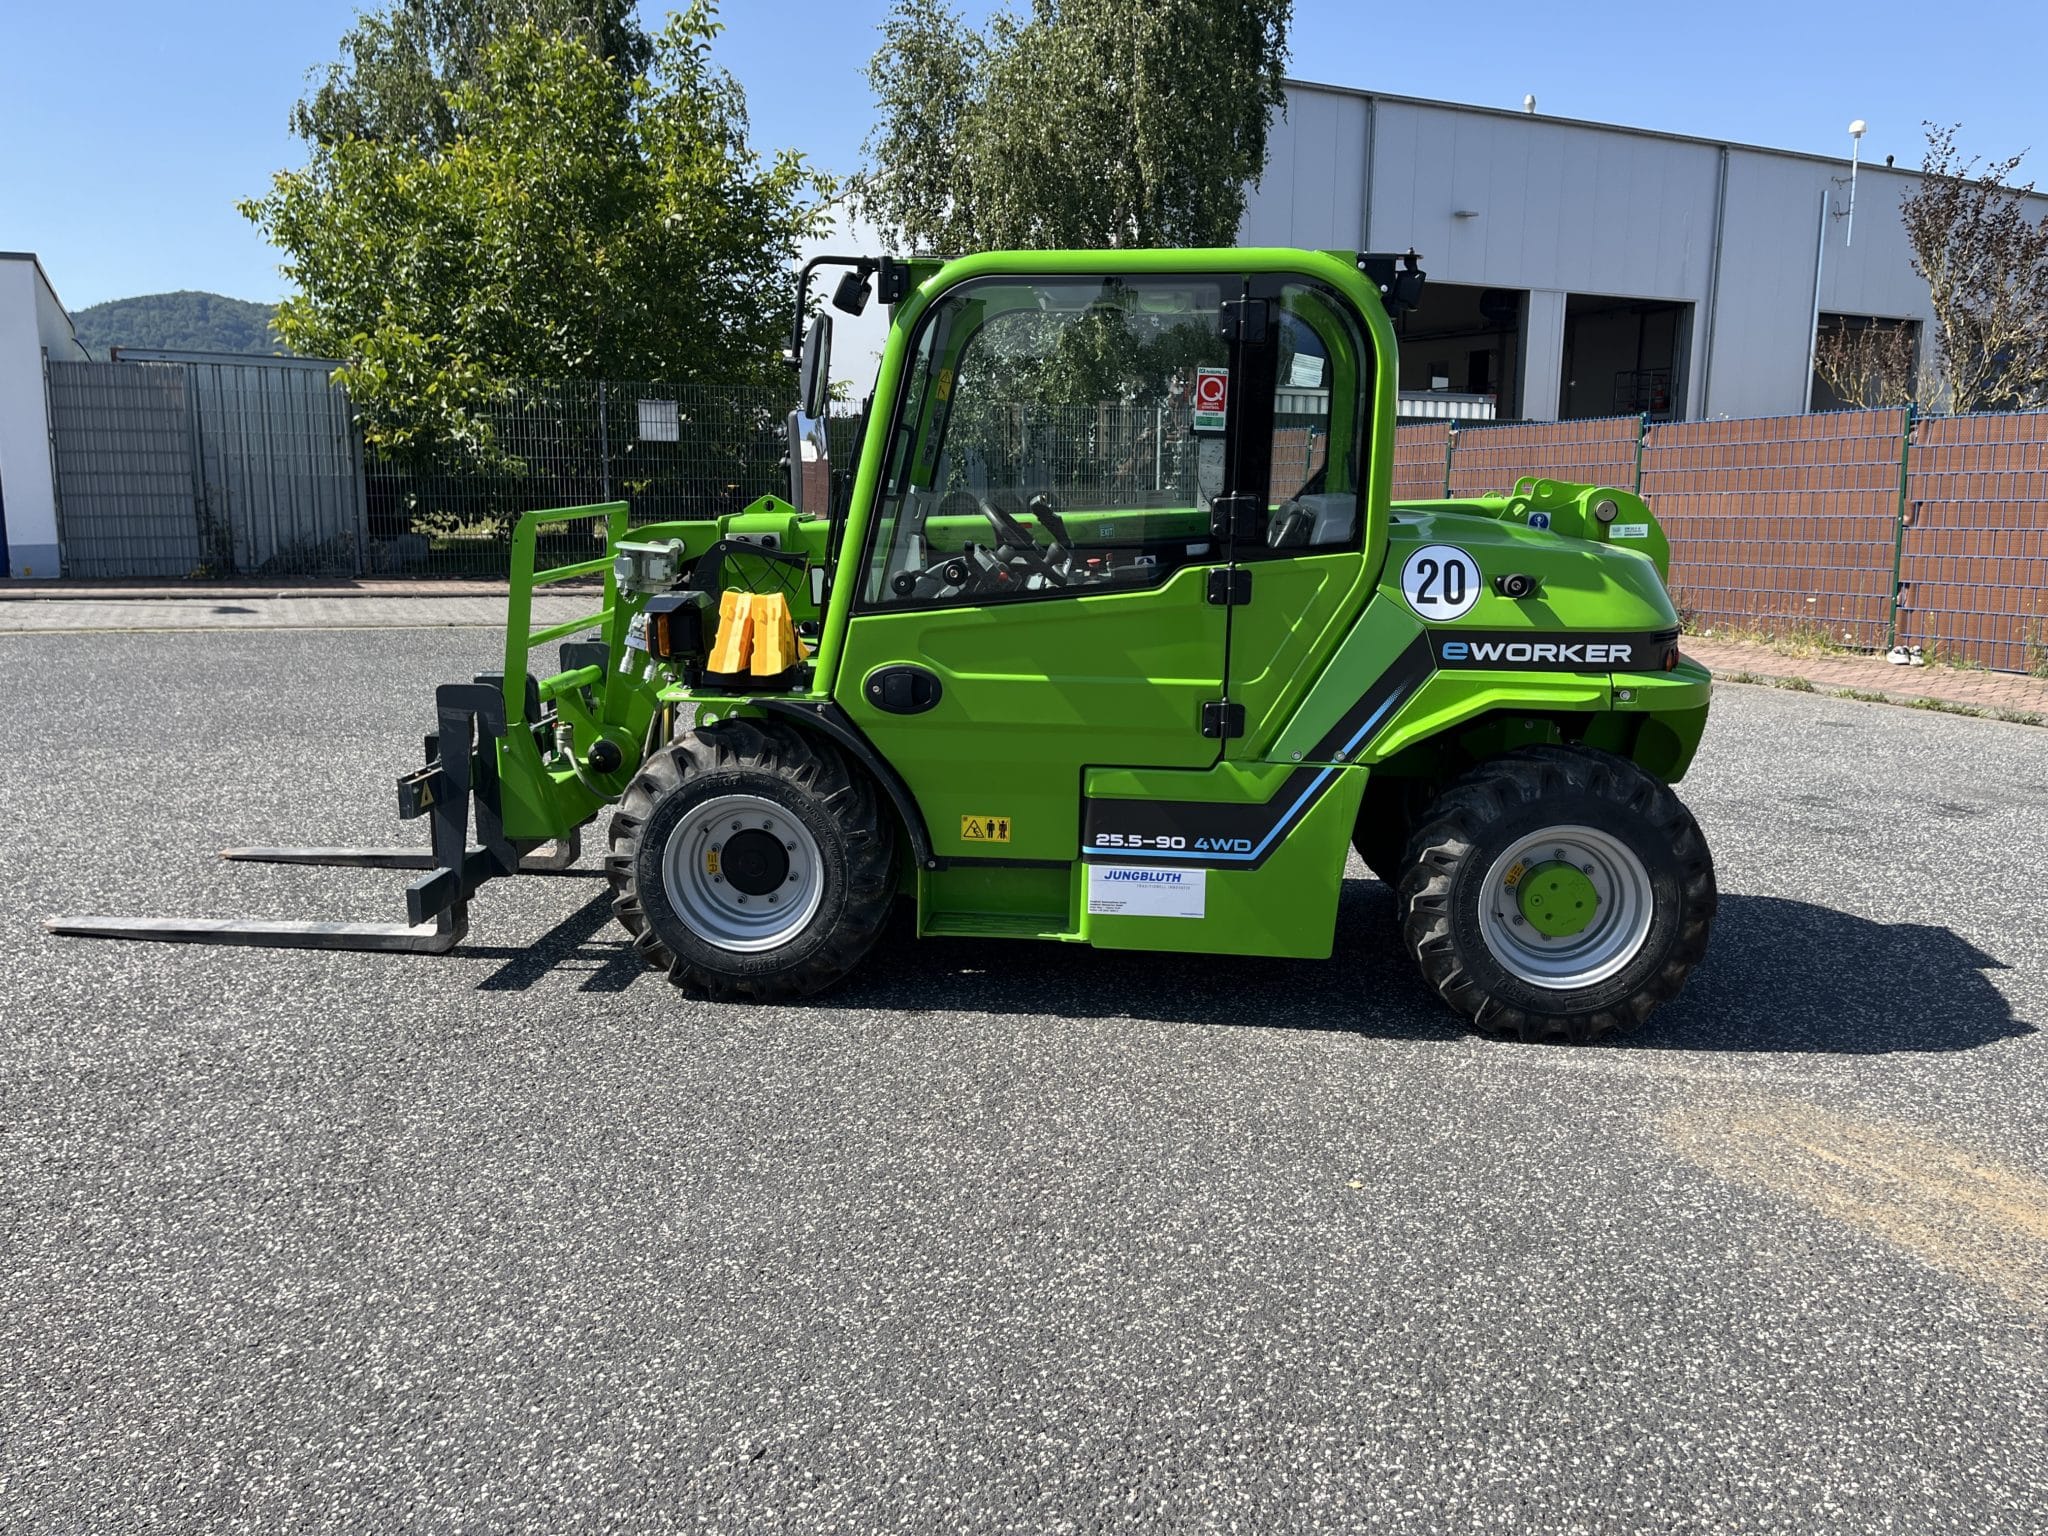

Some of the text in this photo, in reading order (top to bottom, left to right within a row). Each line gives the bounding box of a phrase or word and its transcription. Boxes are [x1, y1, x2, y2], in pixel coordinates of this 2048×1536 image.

[1200, 377, 1224, 402] Q
[1100, 528, 1113, 537] EXIT
[1416, 558, 1466, 605] 20
[1442, 641, 1632, 663] eWORKER
[1096, 833, 1252, 852] 25.5-90 4WD
[1104, 870, 1182, 883] JUNGBLUTH
